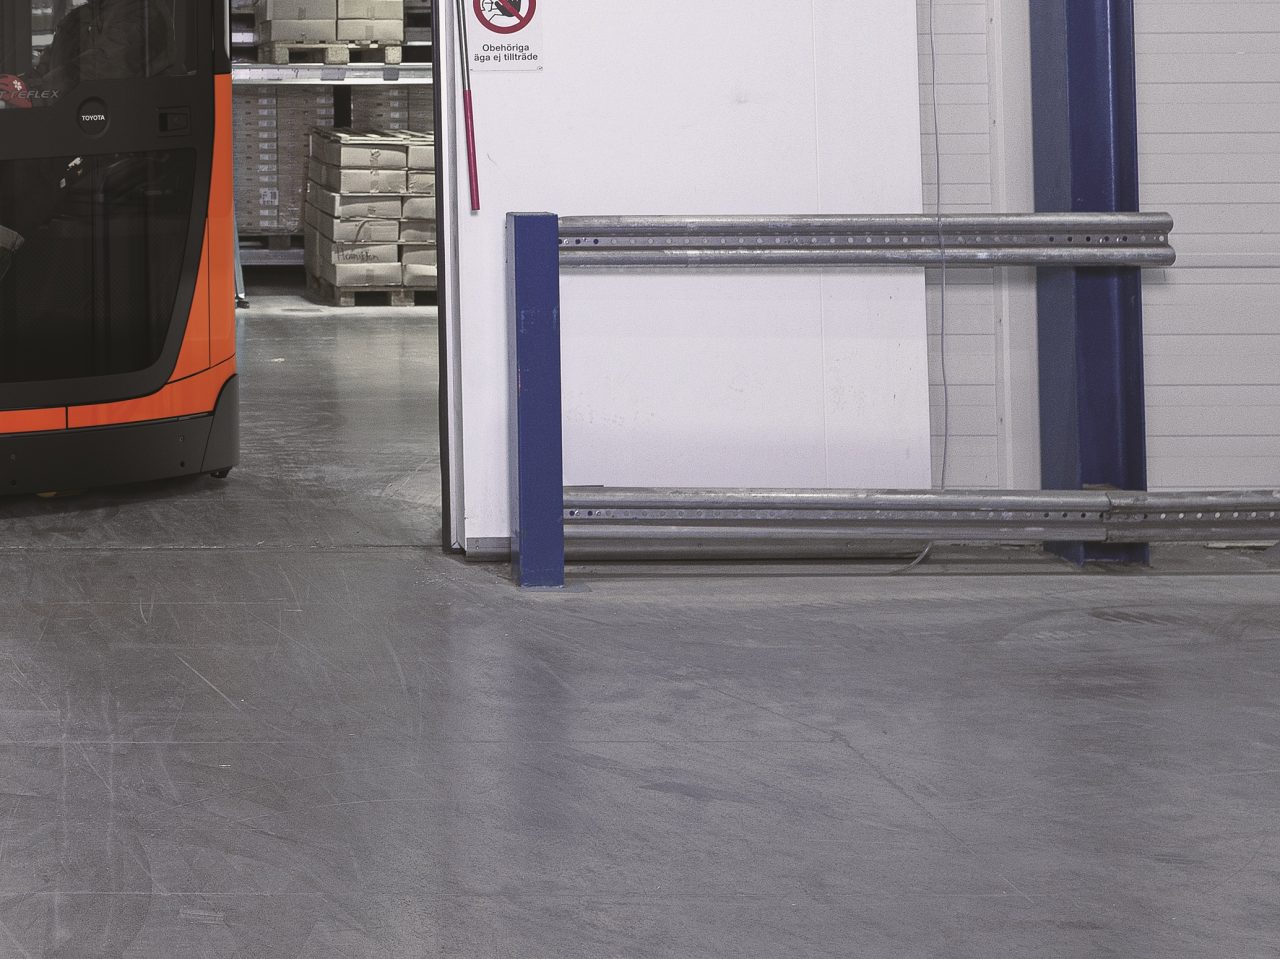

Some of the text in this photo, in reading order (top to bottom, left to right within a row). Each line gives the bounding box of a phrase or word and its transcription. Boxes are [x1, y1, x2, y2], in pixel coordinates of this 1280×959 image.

[482, 44, 529, 53] Obehöriga
[474, 52, 538, 63] äga ej tillträde
